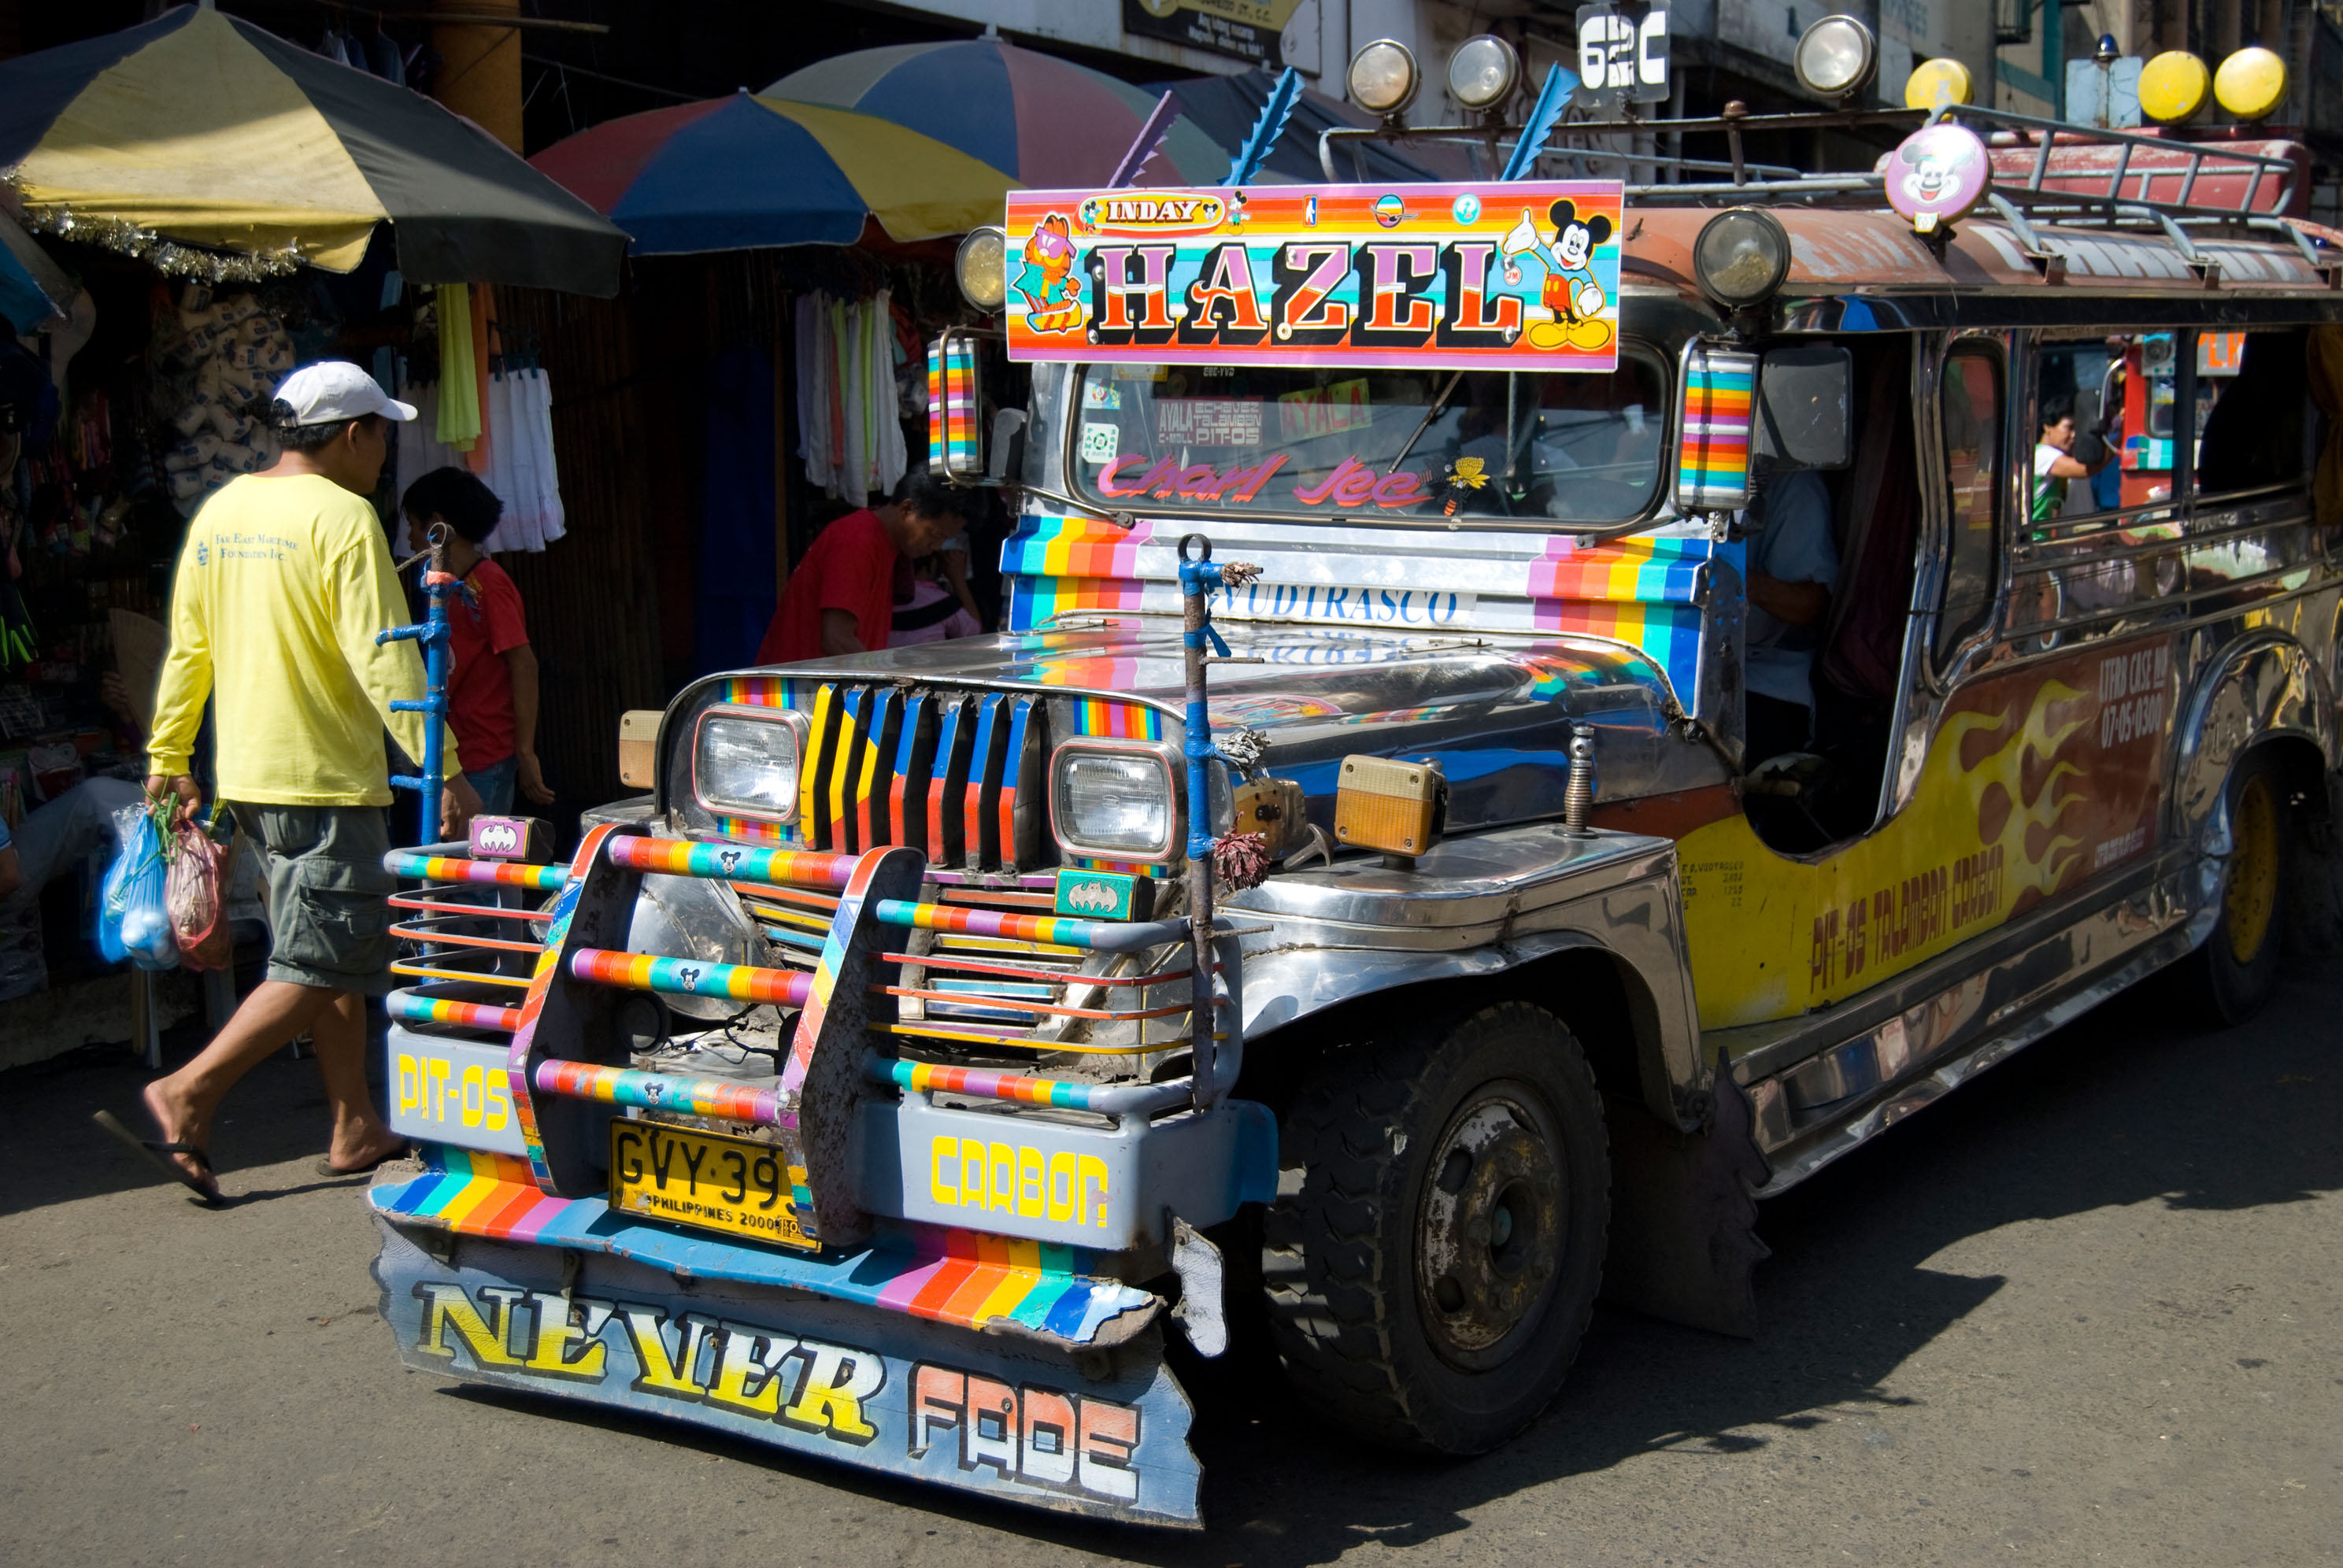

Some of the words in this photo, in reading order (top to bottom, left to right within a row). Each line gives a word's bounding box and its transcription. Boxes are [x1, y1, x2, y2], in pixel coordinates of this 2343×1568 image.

[1579, 11, 1666, 89] 62C
[1106, 200, 1201, 223] INDAY
[1086, 241, 1523, 346] HAZEL
[1159, 402, 1193, 431] AYALA
[1196, 427, 1260, 445] PIT-OS
[1281, 386, 1367, 435] AYALA
[2099, 655, 2127, 703] LTFRB
[2130, 650, 2152, 694] CASE
[1811, 897, 1867, 995] PIT-OS
[398, 1053, 509, 1131] PIT-OS
[415, 1281, 886, 1445] NEVER
[909, 1361, 1142, 1506] FADE
